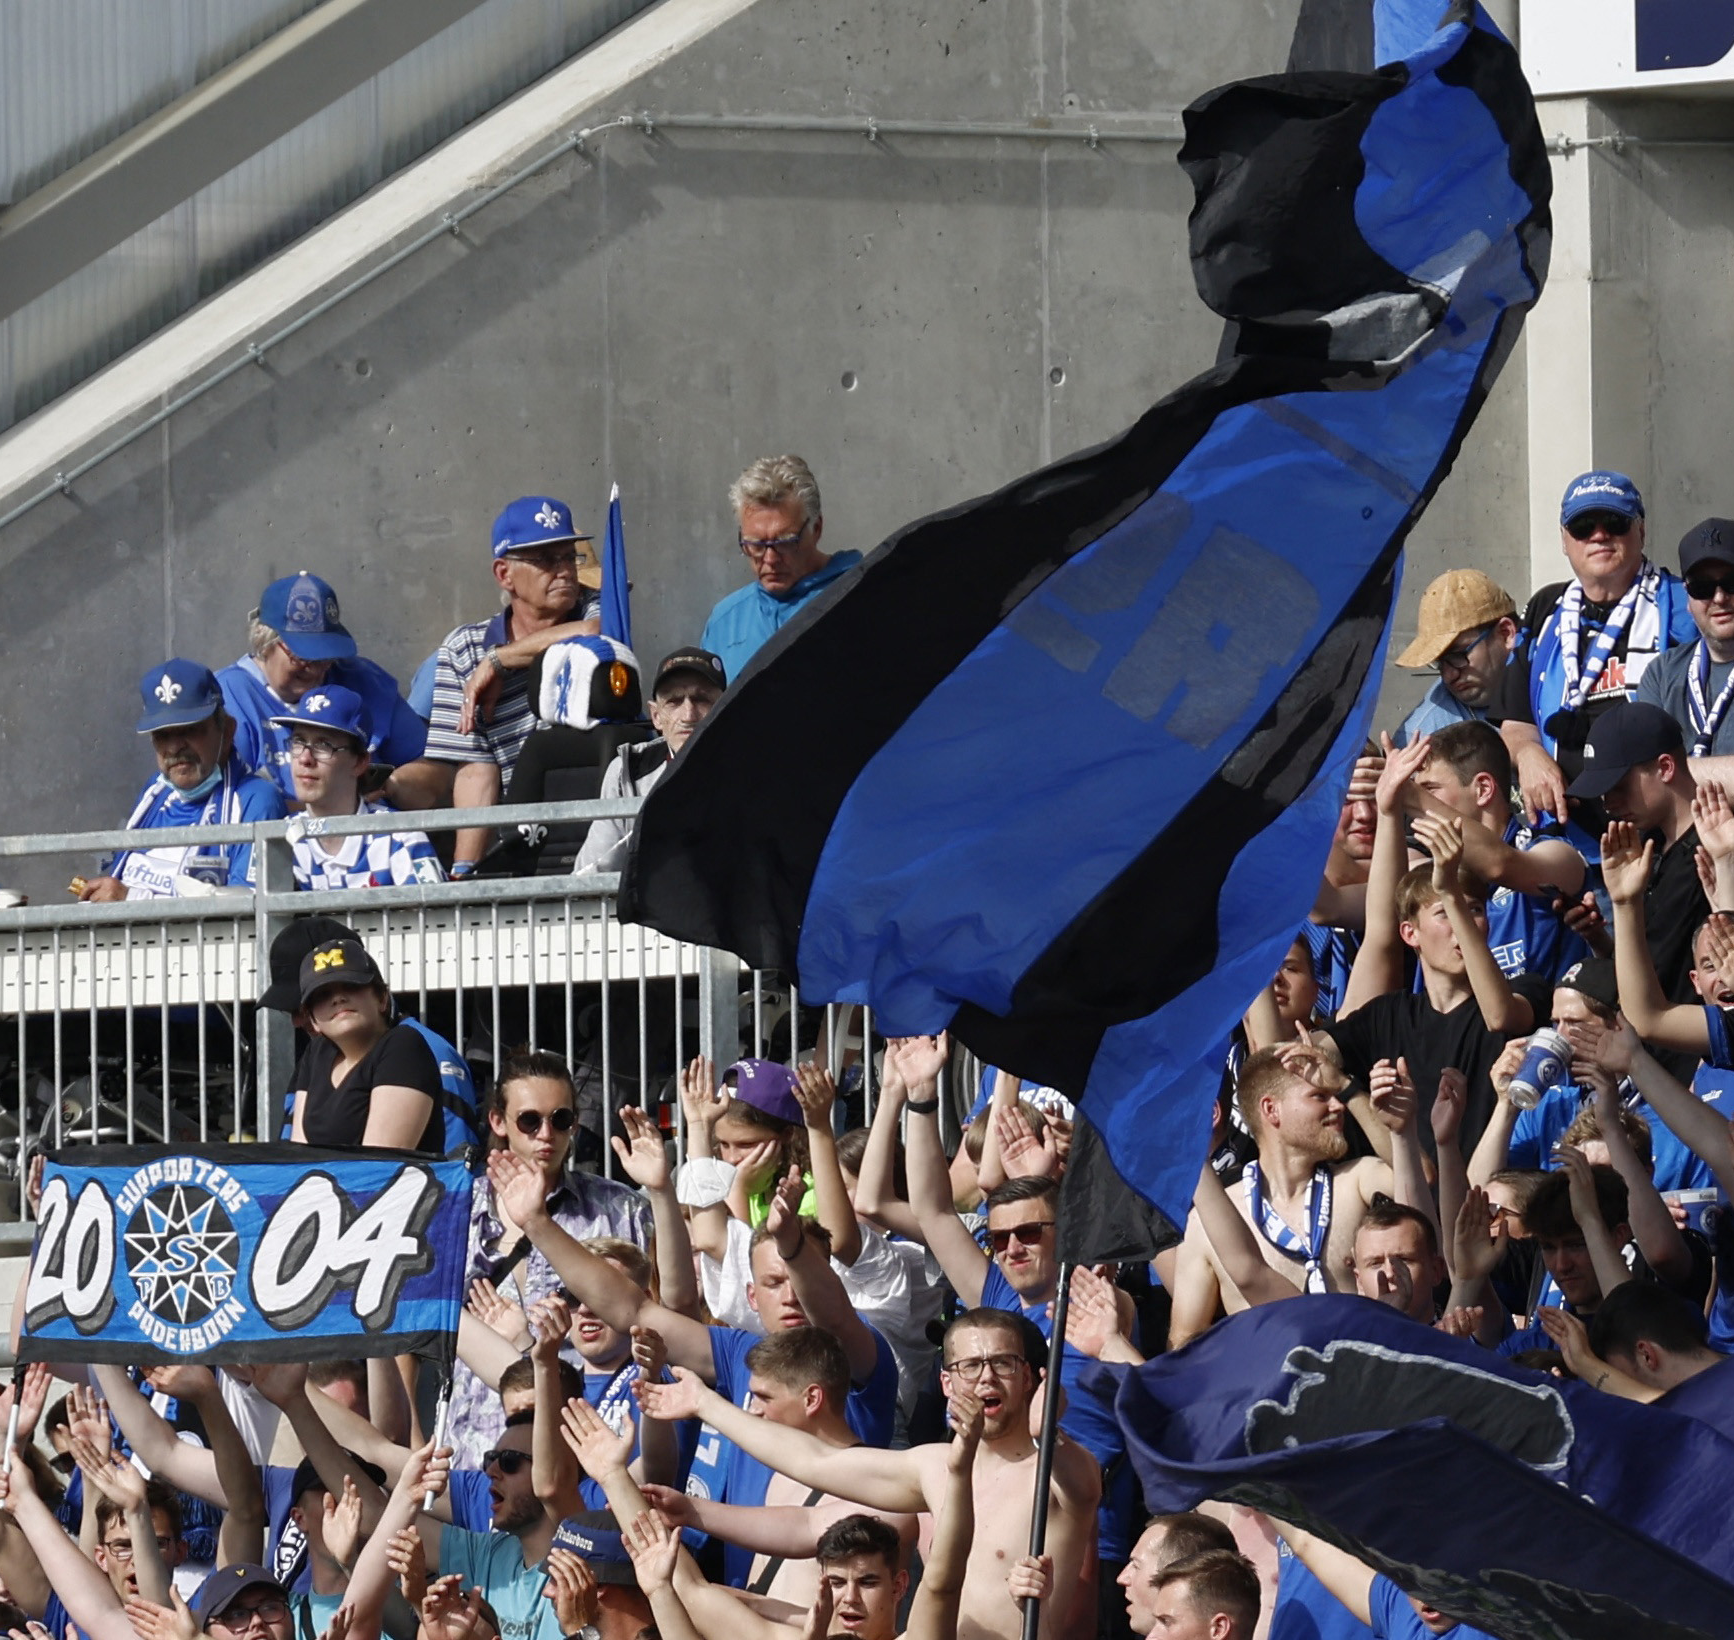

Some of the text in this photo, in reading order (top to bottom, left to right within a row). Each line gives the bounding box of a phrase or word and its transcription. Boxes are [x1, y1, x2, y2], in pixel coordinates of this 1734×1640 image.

[313, 948, 345, 972] M
[114, 1156, 252, 1217] SUPPORTERS
[24, 1166, 430, 1334] 20 04
[127, 1297, 247, 1356] PADERBORN
